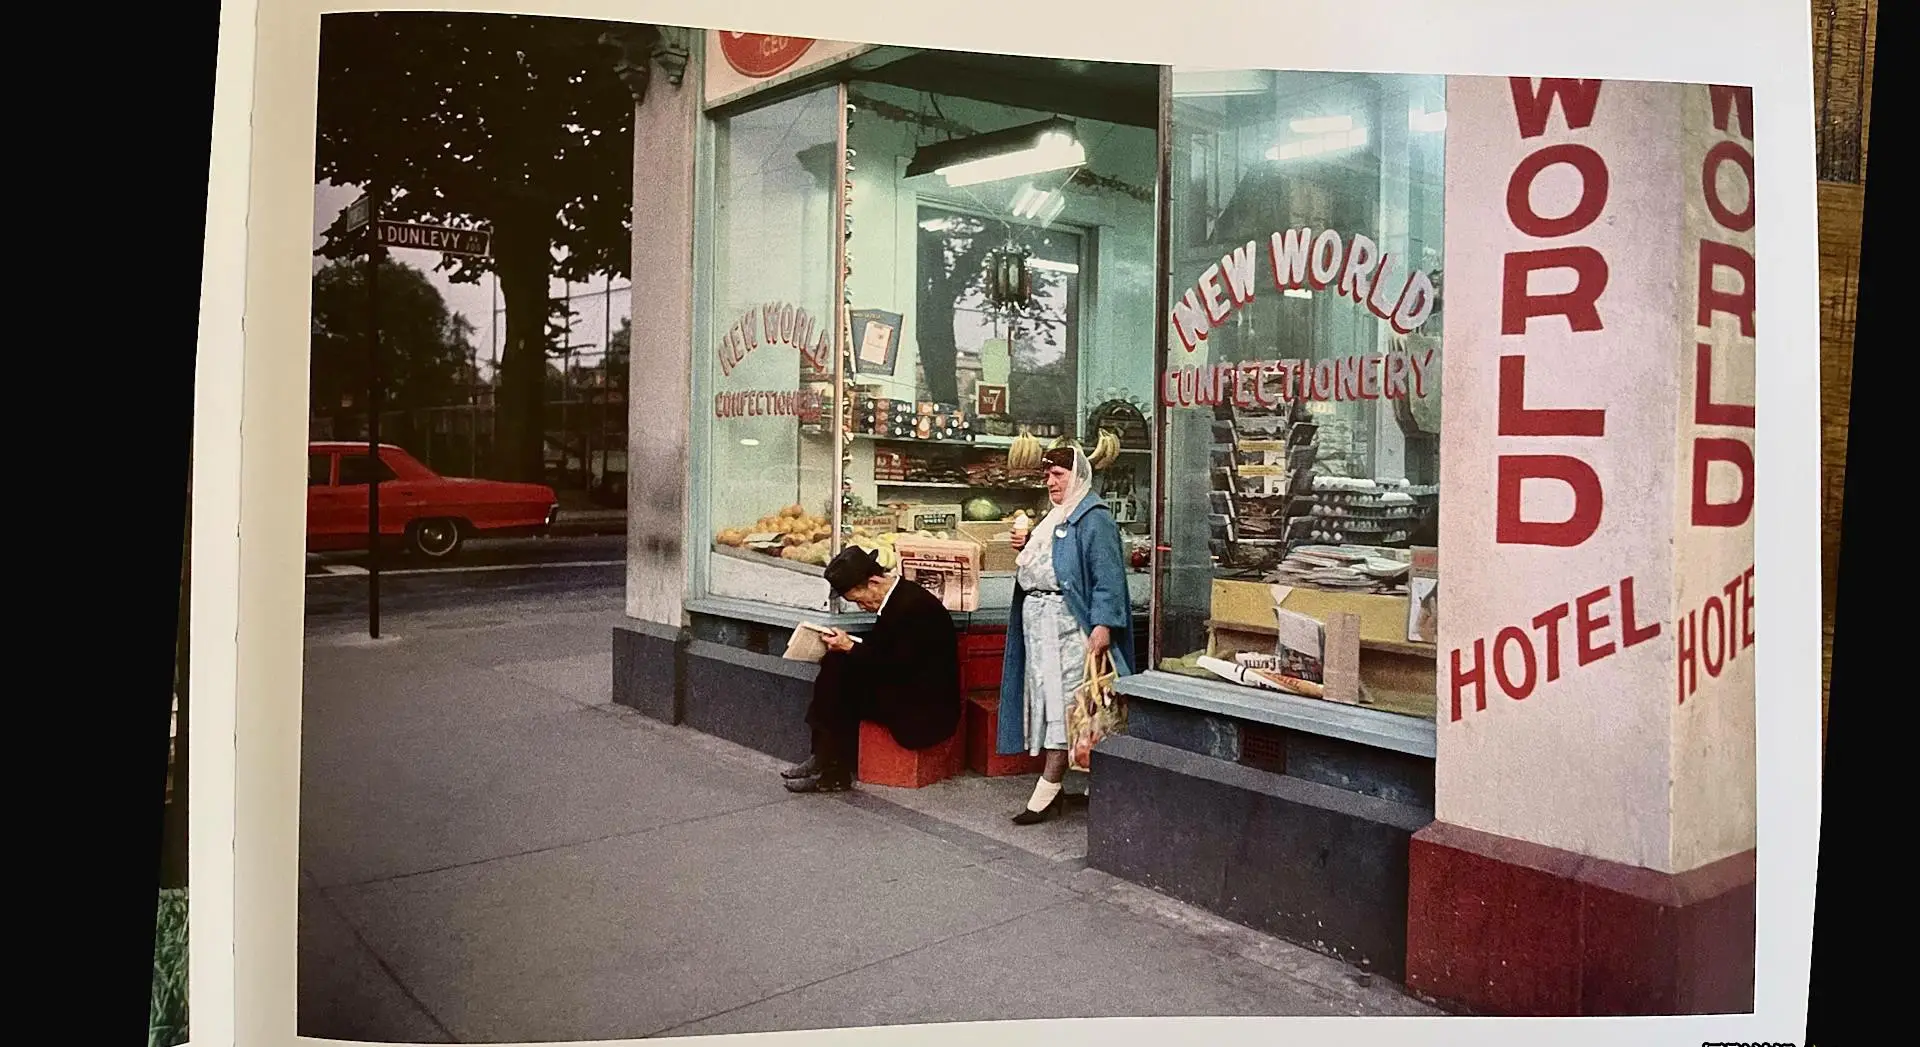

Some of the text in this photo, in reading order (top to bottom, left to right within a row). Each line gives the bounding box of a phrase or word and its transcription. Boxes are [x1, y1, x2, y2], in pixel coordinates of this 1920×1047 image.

[387, 226, 460, 249] DUNLEVY
[1172, 227, 1434, 352] NEW WORLD
[1496, 77, 1609, 547] WORLD
[718, 301, 829, 376] NEW WORLD
[989, 390, 1001, 411] 7
[1160, 349, 1434, 407] CONFECTIONERY
[1450, 575, 1662, 722] HOTEL
